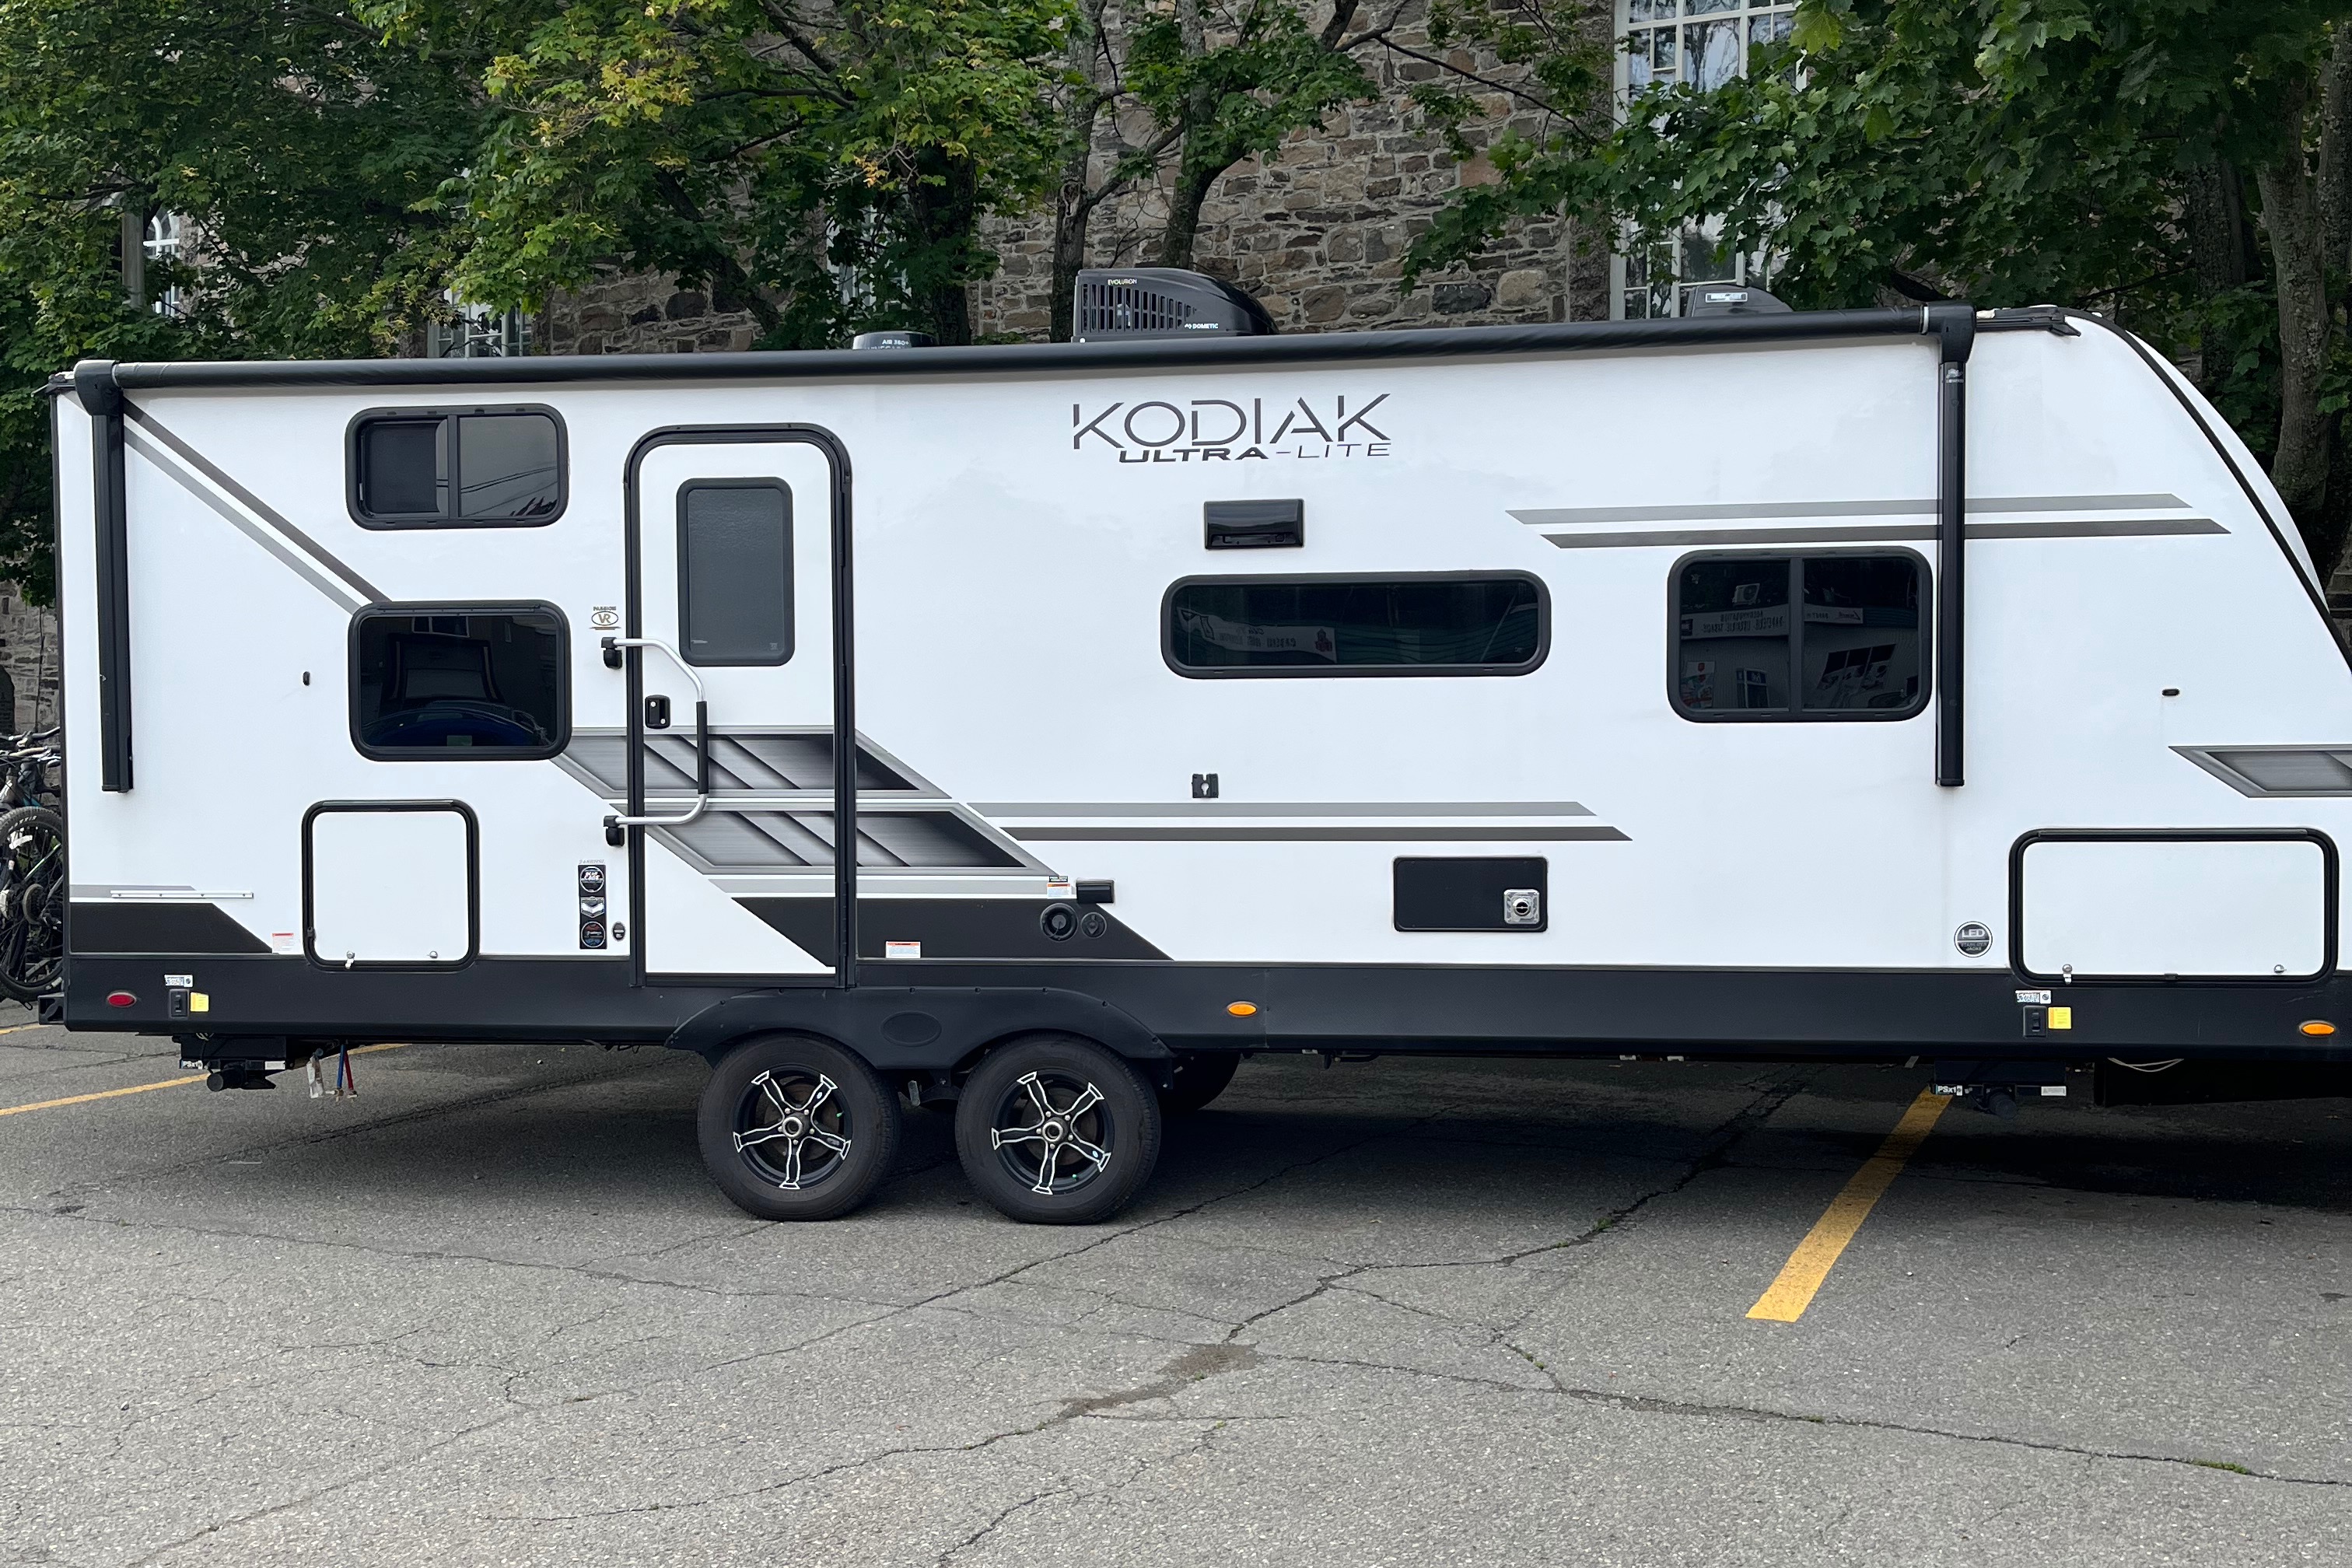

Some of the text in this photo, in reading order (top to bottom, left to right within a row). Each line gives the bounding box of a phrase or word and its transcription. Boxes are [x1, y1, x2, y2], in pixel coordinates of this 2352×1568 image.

[1073, 393, 1391, 450] KODIAK
[1118, 442, 1391, 464] ULTRA-LITE
[598, 613, 611, 624] VR
[1962, 928, 1986, 938] LED
